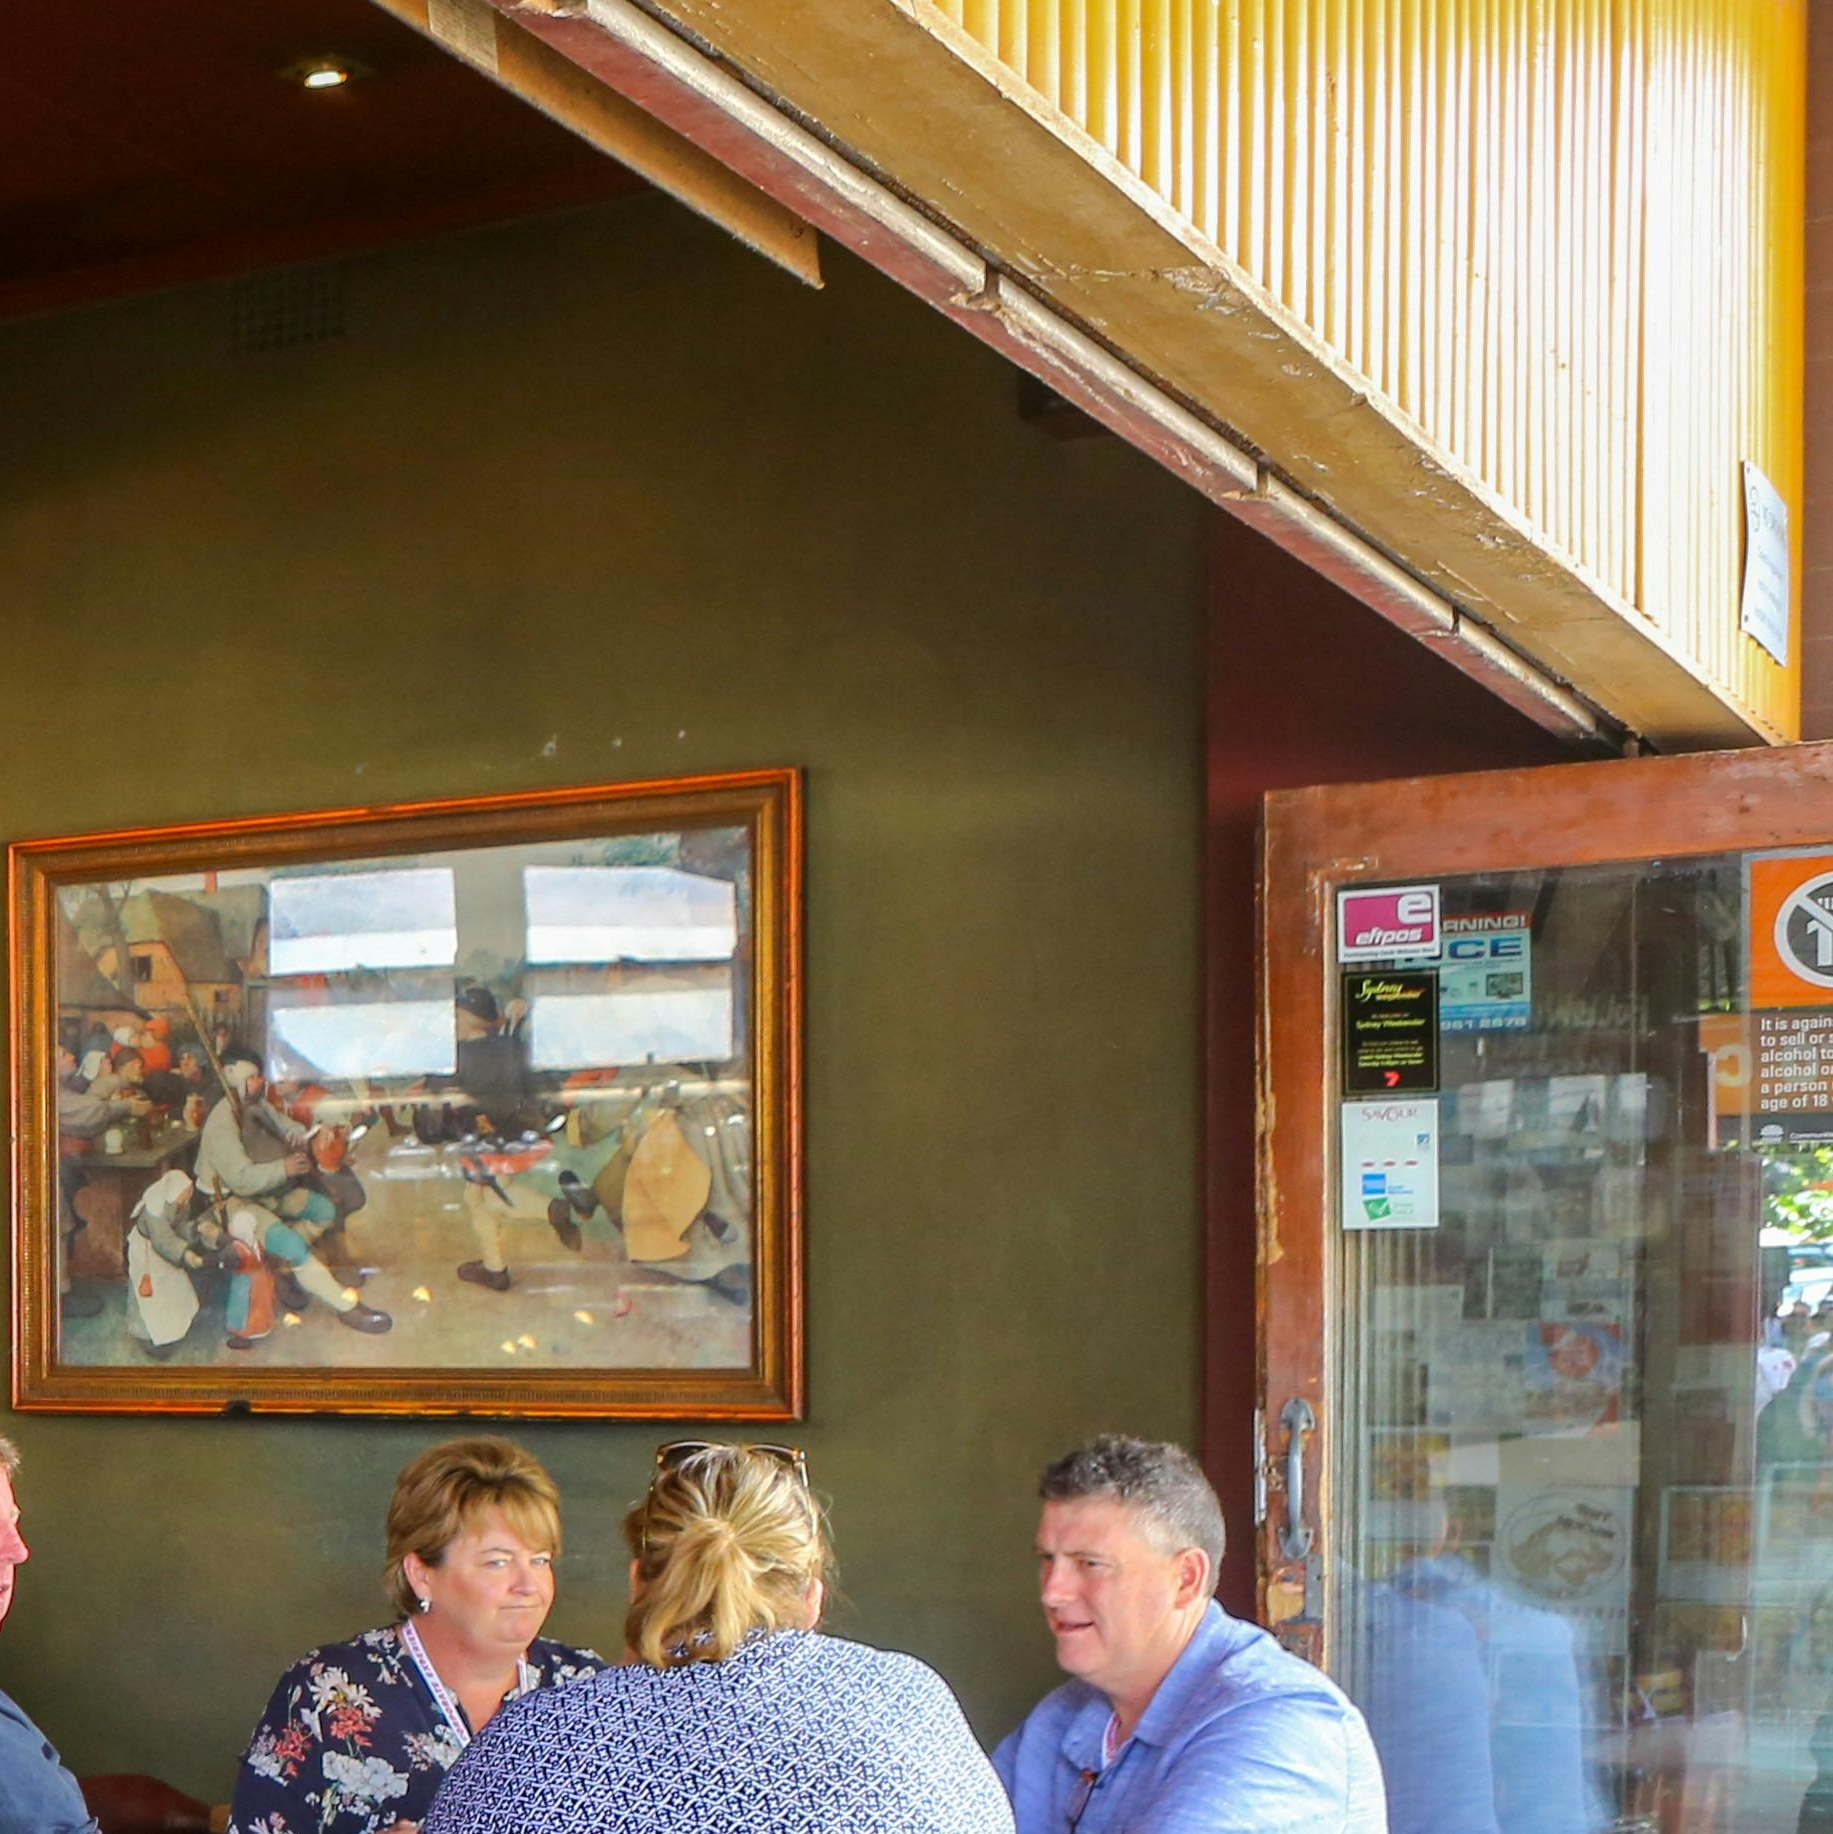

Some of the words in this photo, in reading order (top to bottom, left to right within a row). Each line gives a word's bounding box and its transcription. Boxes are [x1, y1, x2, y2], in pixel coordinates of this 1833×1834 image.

[1355, 927, 1424, 947] eftpos
[1761, 1018, 1772, 1031] It
[1775, 1017, 1787, 1031] is
[1791, 1015, 1833, 1032] again
[1761, 1035, 1776, 1047] to
[1779, 1032, 1805, 1046] sell
[1809, 1033, 1826, 1044] or
[1761, 1047, 1817, 1063] alcohol
[1761, 1063, 1817, 1078] alcohol
[1761, 1083, 1770, 1094] a
[1774, 1081, 1827, 1096] person
[1761, 1098, 1788, 1112] age
[1792, 1094, 1809, 1108] of
[1812, 1094, 1828, 1107] 18
